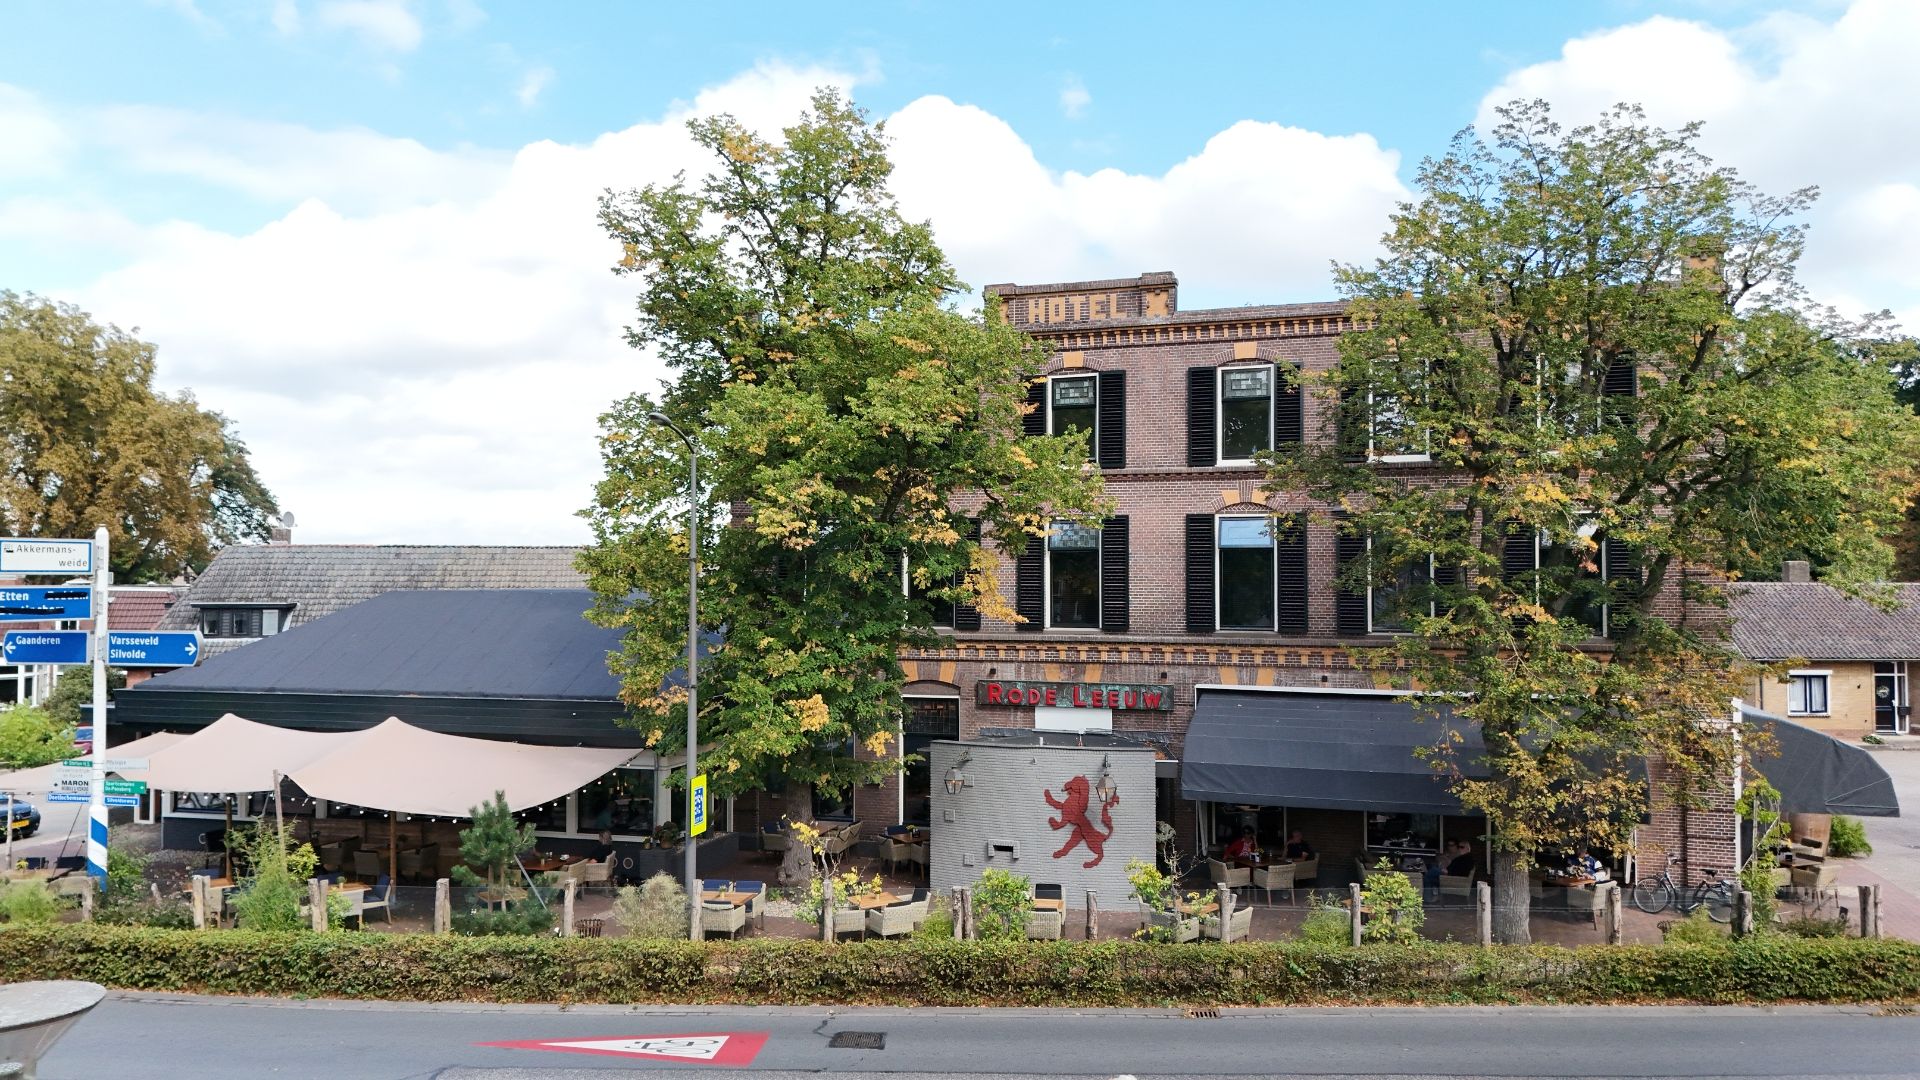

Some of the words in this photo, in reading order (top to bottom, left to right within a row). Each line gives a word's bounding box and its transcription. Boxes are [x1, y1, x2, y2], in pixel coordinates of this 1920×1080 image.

[1028, 293, 1127, 324] HOTEL
[16, 544, 76, 553] Akkermans-
[0, 591, 29, 601] Etten
[15, 635, 61, 645] Gaanderen
[110, 635, 159, 646] Varsseveld
[110, 649, 146, 659] Silvolde
[987, 682, 1056, 705] RODE
[1073, 686, 1161, 708] LEEUW
